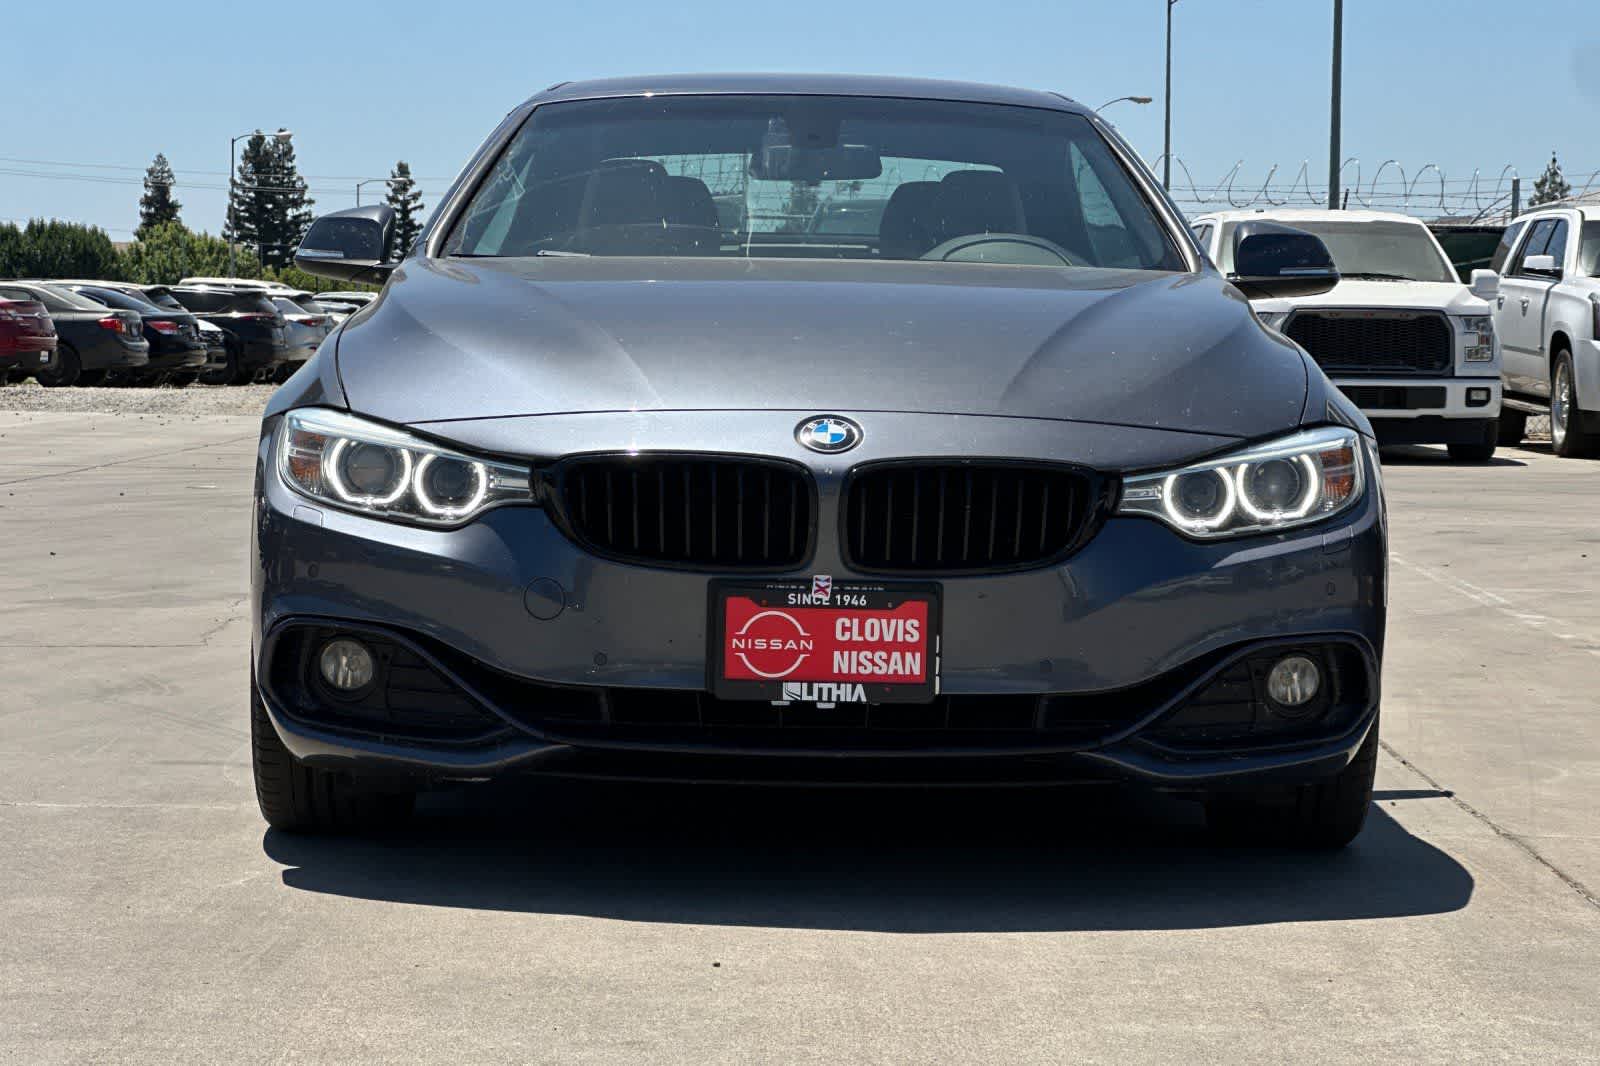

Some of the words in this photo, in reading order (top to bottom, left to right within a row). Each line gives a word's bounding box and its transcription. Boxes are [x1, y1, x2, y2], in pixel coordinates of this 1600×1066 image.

[788, 593, 831, 606] SINCE
[835, 595, 867, 606] 1946
[835, 617, 920, 642] CLOVIS
[732, 638, 813, 651] NISSAN
[833, 650, 921, 675] NISSAN
[801, 682, 867, 702] LITHIA
